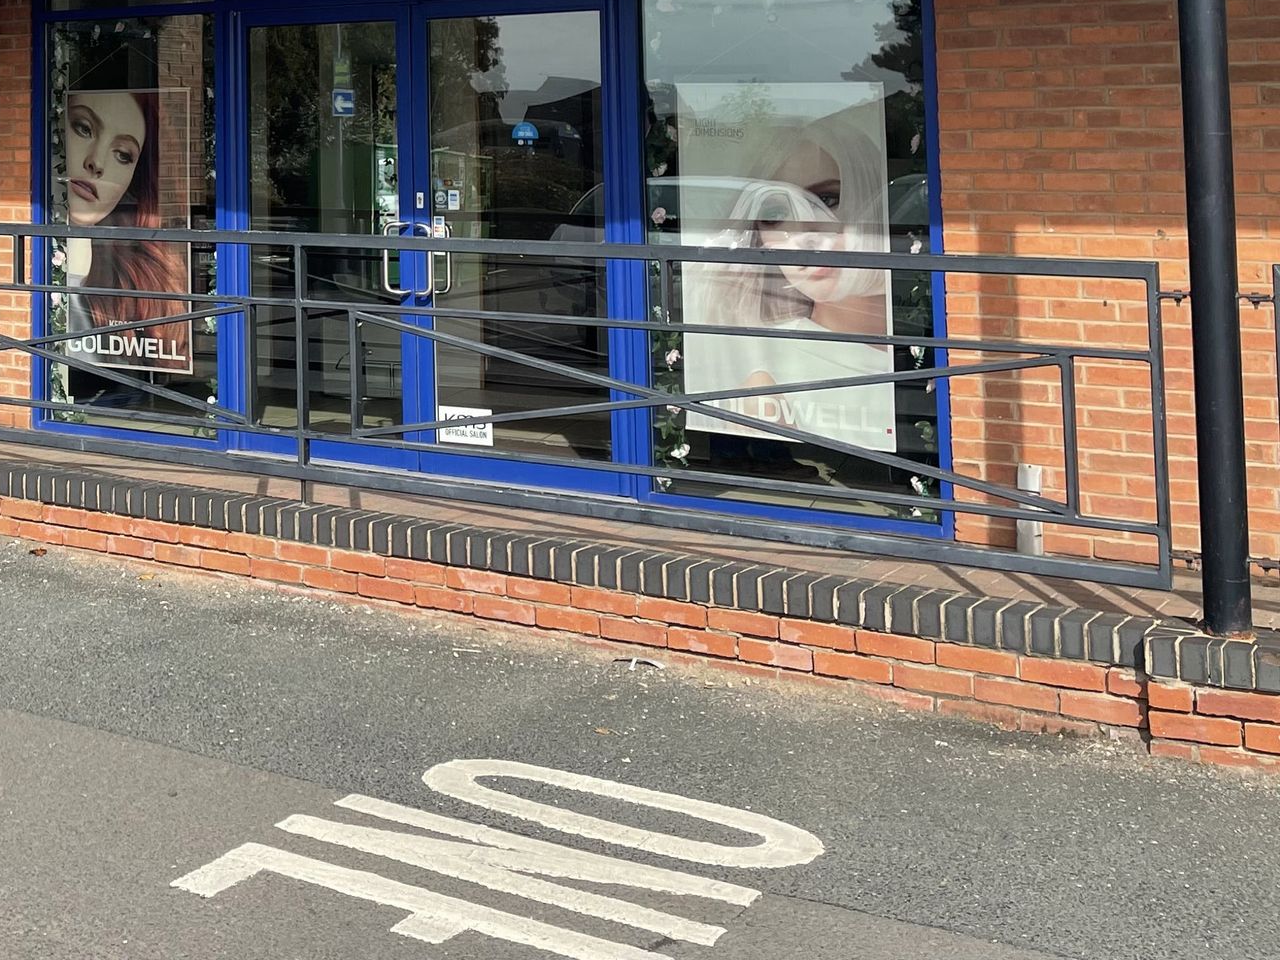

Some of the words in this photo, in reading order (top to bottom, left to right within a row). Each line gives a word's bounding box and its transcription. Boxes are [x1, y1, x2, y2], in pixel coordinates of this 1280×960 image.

[67, 334, 187, 361] GOLDWELL
[710, 393, 883, 434] LDWELL
[444, 428, 469, 438] OFFICIAL
[469, 430, 488, 440] SALON
